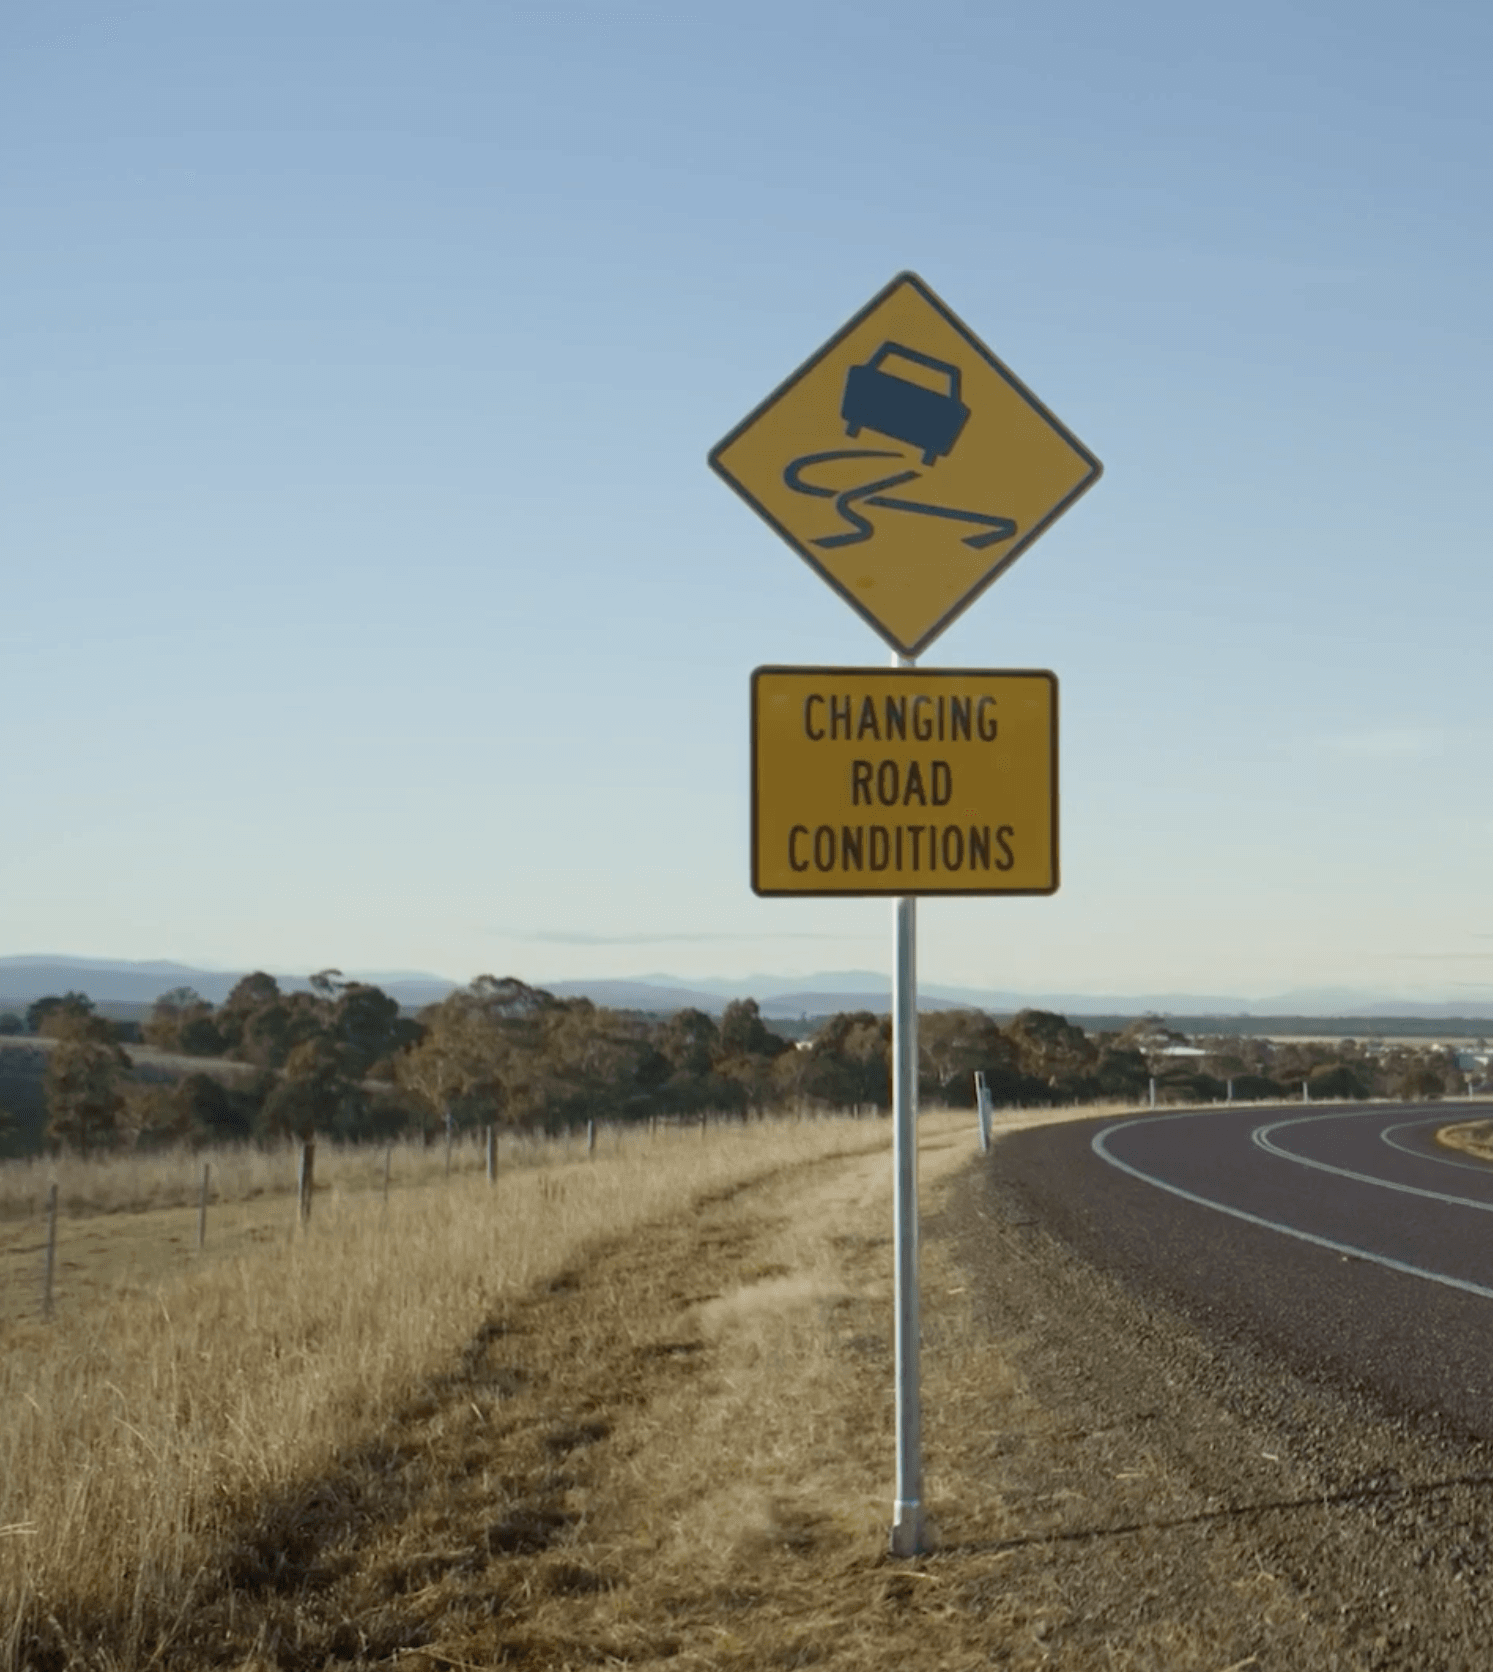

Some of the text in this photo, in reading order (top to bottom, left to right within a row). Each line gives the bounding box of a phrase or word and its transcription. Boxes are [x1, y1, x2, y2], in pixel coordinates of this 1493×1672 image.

[803, 692, 999, 743] CHANGING
[849, 757, 954, 808] ROAD
[787, 822, 1016, 874] CONDITIONS
